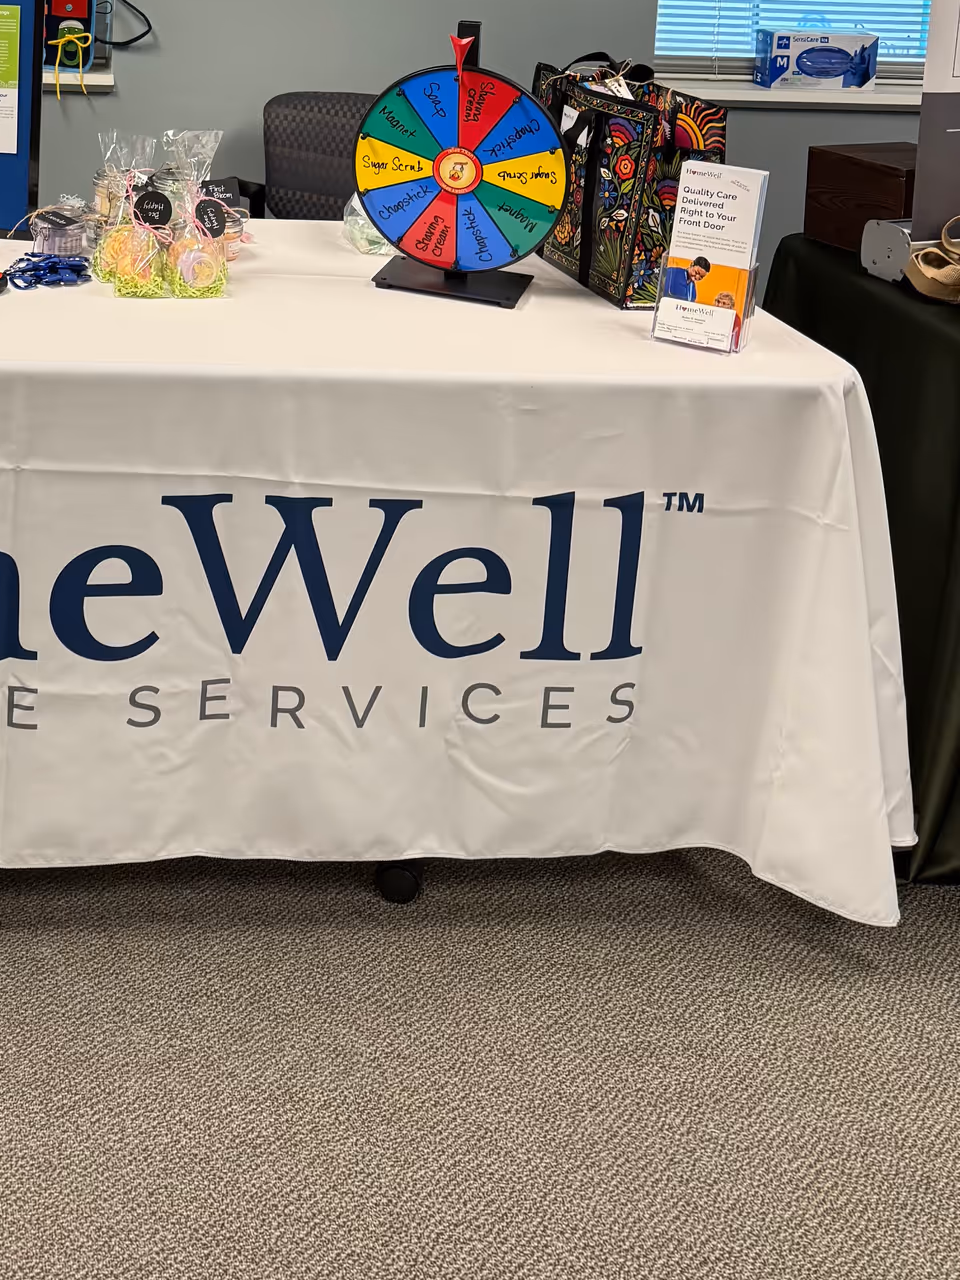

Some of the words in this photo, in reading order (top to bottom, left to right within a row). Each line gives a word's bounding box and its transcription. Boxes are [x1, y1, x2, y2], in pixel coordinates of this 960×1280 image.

[776, 56, 788, 68] M
[423, 82, 446, 118] Soap
[472, 81, 497, 123] Shaving
[378, 105, 417, 139] Magnet
[482, 119, 540, 158] Chapstick
[362, 155, 388, 174] Sugar
[392, 160, 424, 172] Scrub
[530, 166, 558, 184] Sugar
[498, 172, 528, 184] Scrub
[143, 200, 164, 211] Happy
[378, 184, 434, 220] Chapstick
[682, 196, 724, 210] Delivered
[683, 186, 715, 198] Quality
[716, 191, 738, 200] Care
[496, 203, 537, 234] Magnet
[678, 217, 700, 227] Front
[703, 220, 726, 230] Door
[680, 206, 703, 217] Right
[716, 212, 737, 222] Your
[415, 214, 444, 252] Shaving
[462, 206, 492, 262] Chapstick
[126, 678, 636, 730] SERVICES
